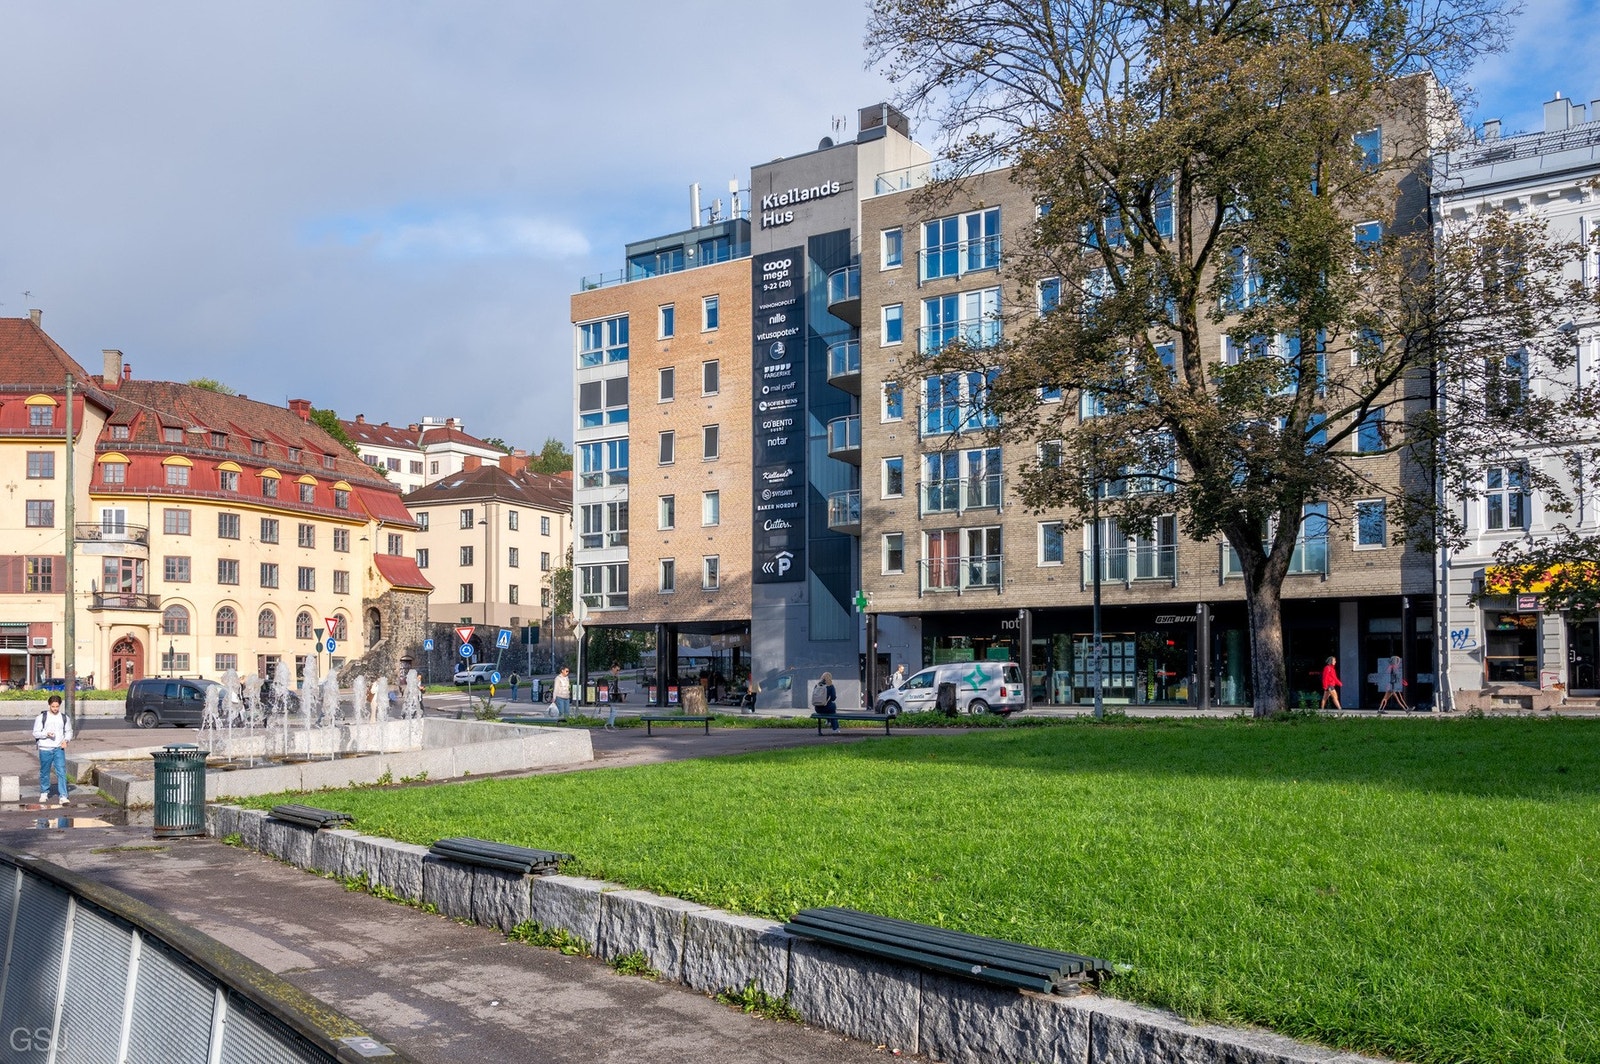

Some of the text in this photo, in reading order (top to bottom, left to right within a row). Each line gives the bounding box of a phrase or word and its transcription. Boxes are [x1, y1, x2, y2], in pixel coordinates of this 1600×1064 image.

[763, 180, 840, 209] Kiellands
[763, 211, 794, 227] Hus
[763, 259, 792, 271] coop
[763, 270, 789, 280] mega
[763, 280, 792, 291] 9-22 (20)
[759, 300, 796, 309] VINMONOPOLET
[769, 313, 786, 325] nille
[764, 370, 791, 379] FARGERIKE
[767, 437, 788, 447] notar
[775, 502, 798, 510] NORDBY
[778, 558, 791, 576] P
[1001, 617, 1020, 630] not
